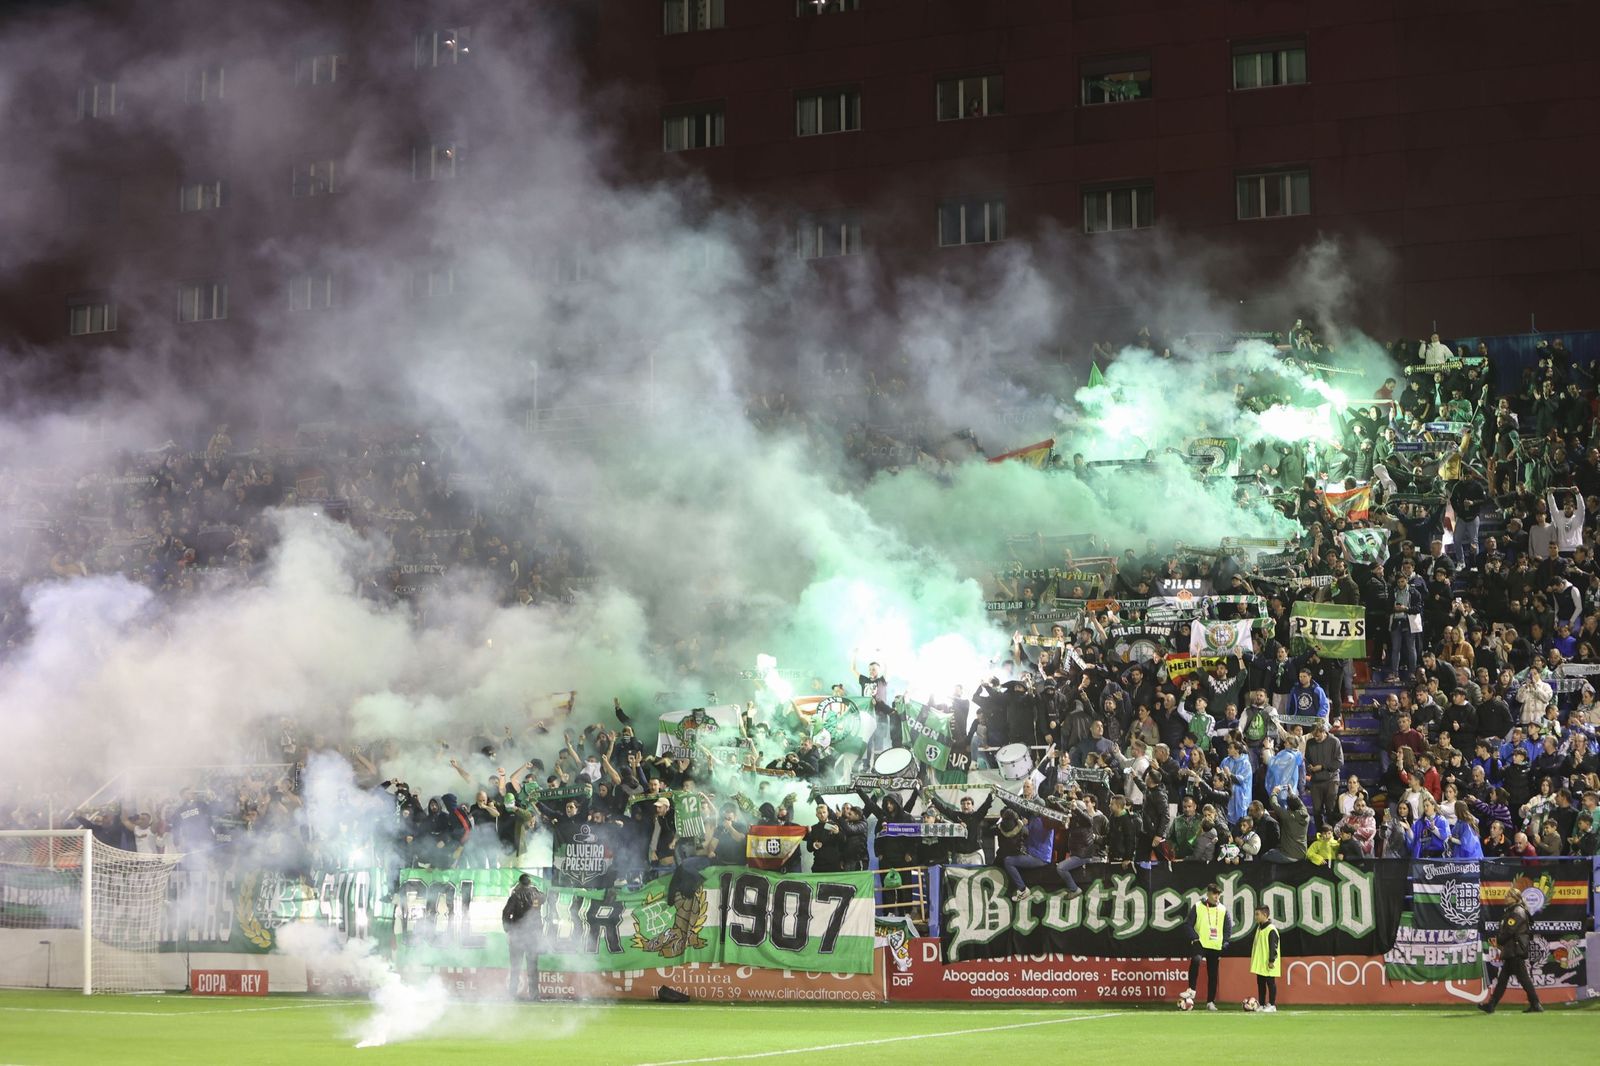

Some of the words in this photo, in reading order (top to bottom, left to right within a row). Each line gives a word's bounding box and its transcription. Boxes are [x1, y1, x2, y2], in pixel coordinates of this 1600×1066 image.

[1163, 578, 1201, 590] PILAS
[1110, 626, 1142, 638] PILAS
[1145, 625, 1171, 637] FANS
[1295, 617, 1364, 637] PILAS
[949, 753, 969, 771] UR
[681, 795, 698, 813] 12
[565, 857, 603, 871] PRESENTE
[719, 872, 858, 954] 1907
[1424, 943, 1478, 966] BETIS
[198, 973, 226, 992] COPA
[241, 974, 261, 993] REY
[892, 976, 914, 987] DaP
[942, 969, 1009, 985] Abogados
[1021, 968, 1099, 982] Mediadores
[1111, 968, 1189, 983] Economista
[694, 986, 707, 998] 10
[710, 986, 724, 998] 75
[727, 986, 742, 998] 39
[748, 986, 876, 1001] www.clinicadfranco.es
[970, 986, 1077, 998] abogadosdap.com
[1097, 986, 1118, 997] 924
[1121, 986, 1142, 997] 695
[1145, 986, 1166, 997] 110
